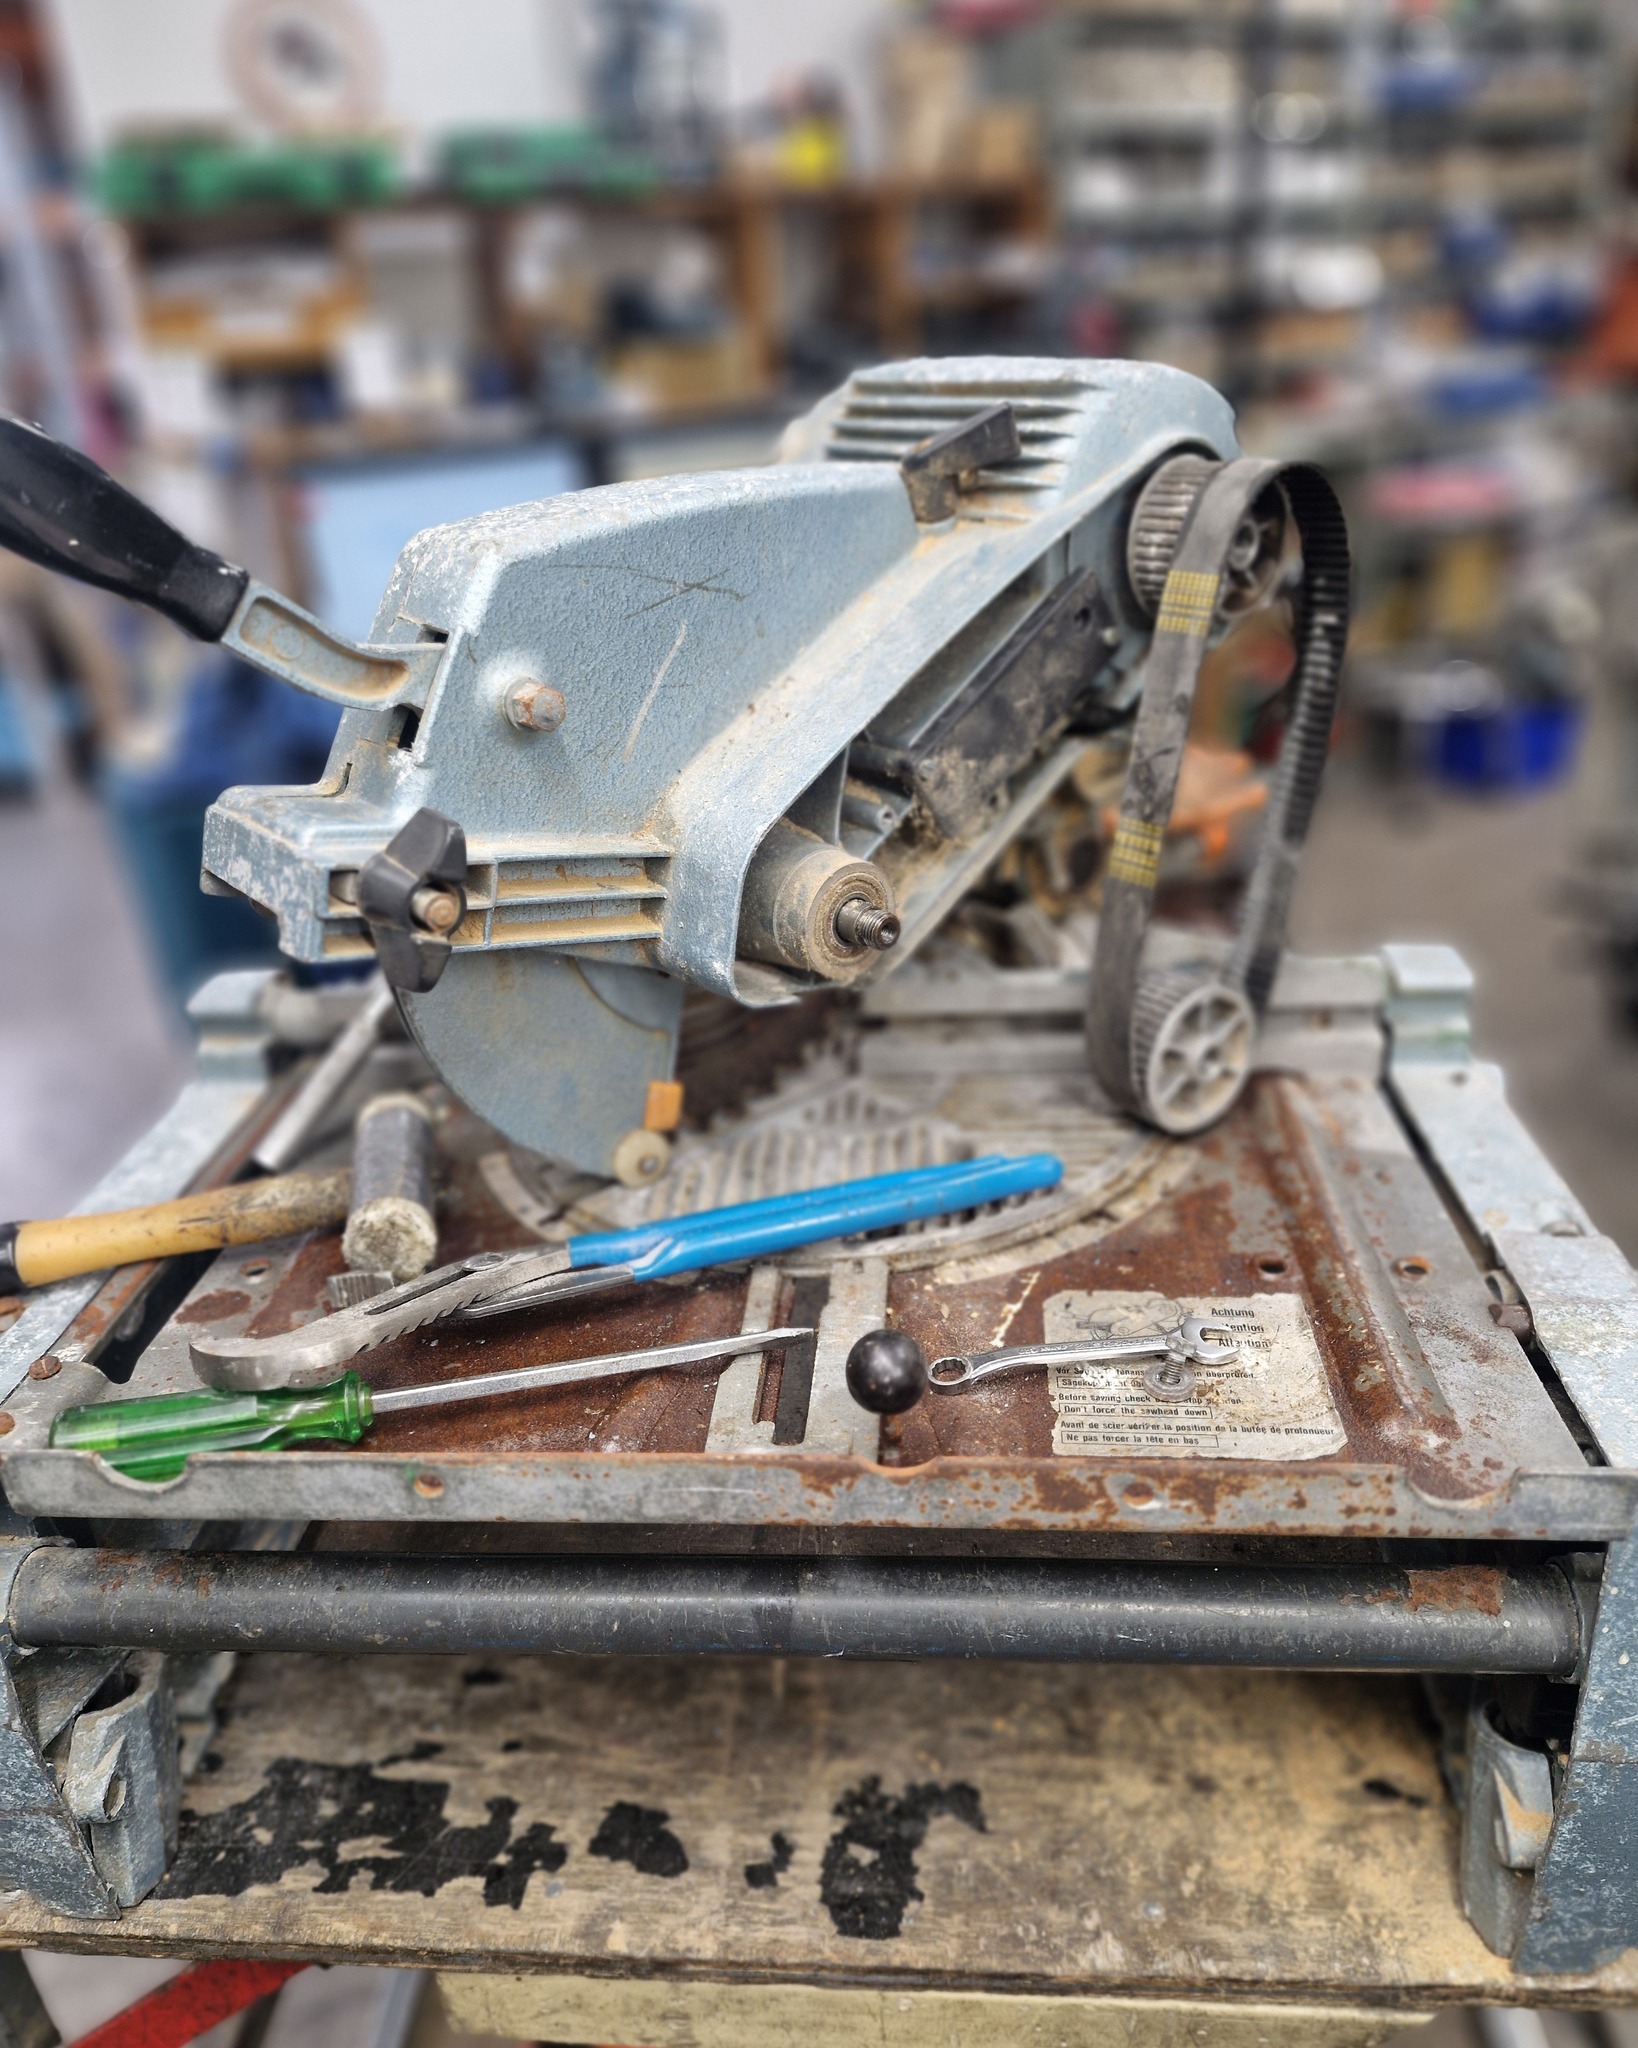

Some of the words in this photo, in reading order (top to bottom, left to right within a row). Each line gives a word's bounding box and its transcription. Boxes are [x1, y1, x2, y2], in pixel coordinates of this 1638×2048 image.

[1211, 1308, 1255, 1318] Achtung
[1221, 1323, 1265, 1334] ention
[1058, 1393, 1087, 1401] Before
[1090, 1394, 1121, 1403] sawing
[1125, 1395, 1151, 1403] check
[1064, 1405, 1087, 1413] Don't
[1092, 1405, 1116, 1414] force
[1120, 1406, 1136, 1414] the
[1140, 1407, 1179, 1415] sawhead
[1184, 1408, 1208, 1416] down
[1060, 1420, 1084, 1429] Avant
[1088, 1421, 1099, 1429] de
[1102, 1421, 1125, 1429] scier
[1163, 1423, 1173, 1431] la
[1175, 1424, 1212, 1432] position
[1215, 1424, 1226, 1432] de
[1241, 1425, 1267, 1434] butée
[1270, 1426, 1281, 1434] de
[1066, 1433, 1079, 1441] Ne
[1083, 1434, 1099, 1443] pas
[1102, 1434, 1130, 1442] forcer
[1146, 1435, 1164, 1443] tête
[1168, 1436, 1179, 1444] en
[1183, 1436, 1200, 1445] bas
